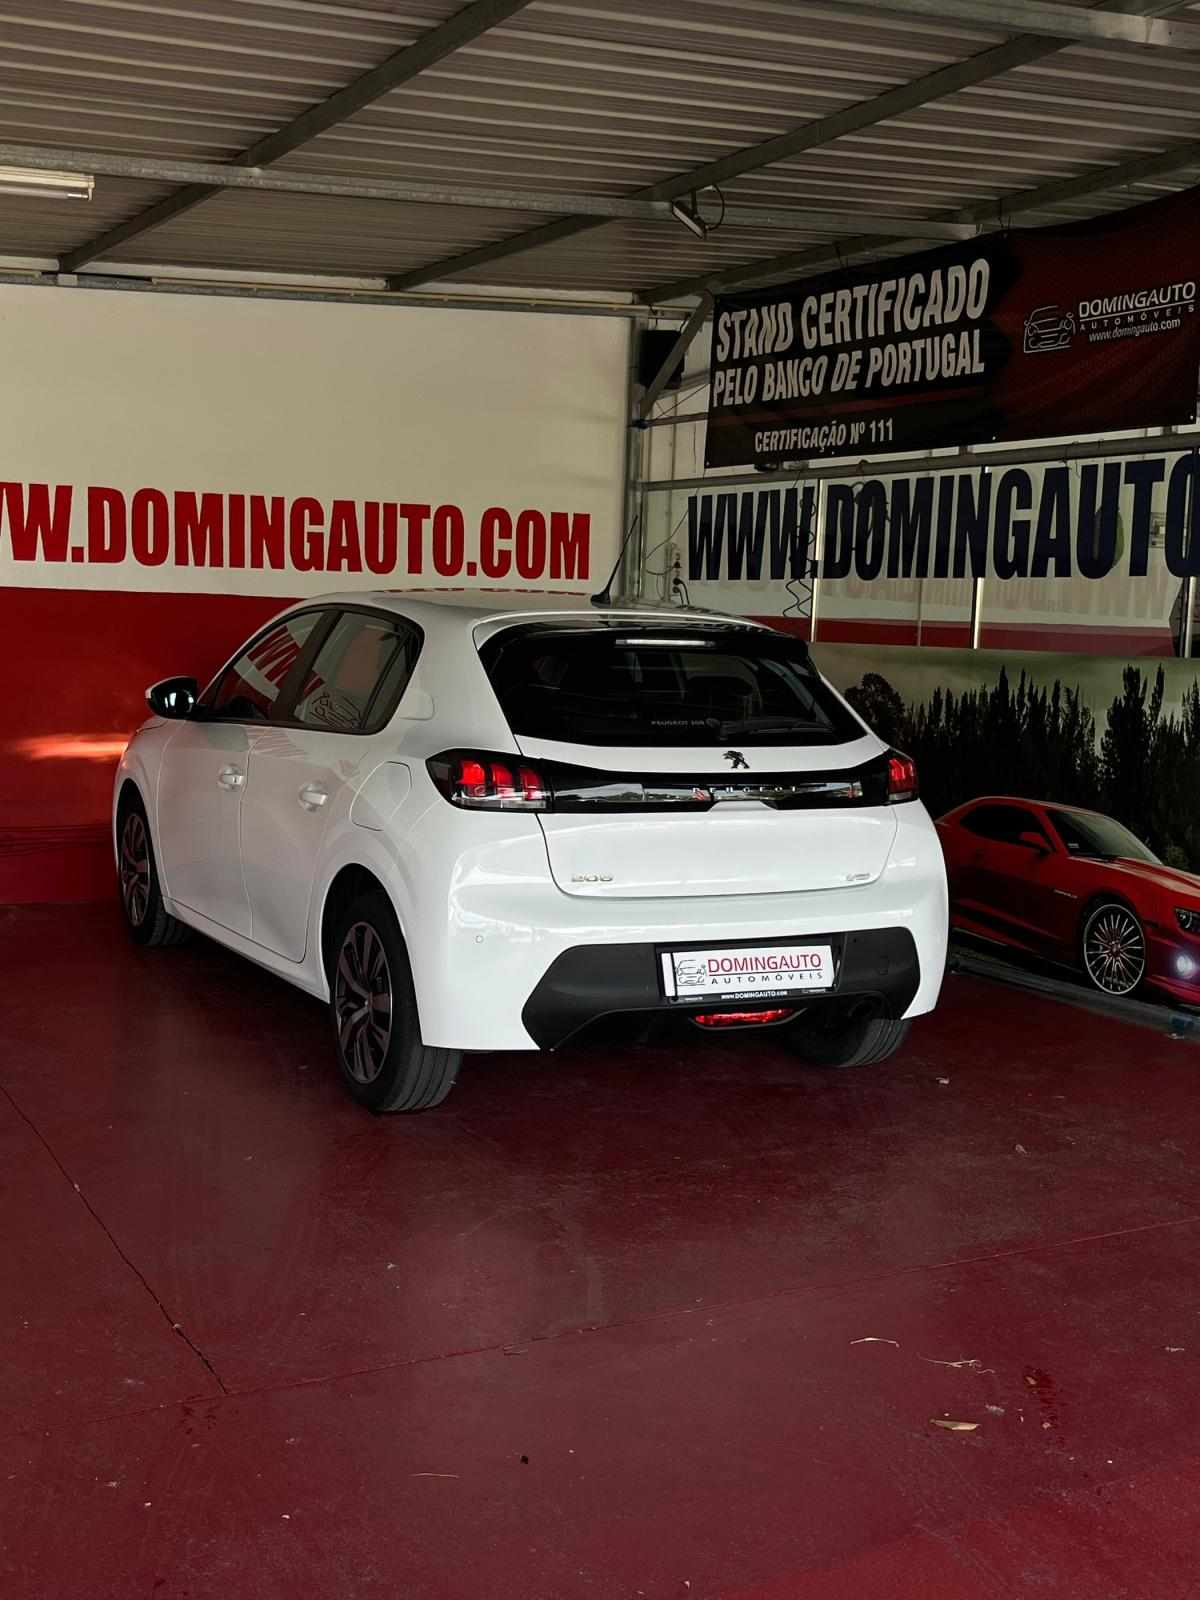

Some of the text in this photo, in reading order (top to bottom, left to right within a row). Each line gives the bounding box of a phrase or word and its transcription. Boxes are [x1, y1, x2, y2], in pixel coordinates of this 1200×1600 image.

[716, 258, 991, 363] STAND CERTIFICADO
[1078, 281, 1196, 318] DOMINGAUTO
[1080, 305, 1195, 331] AUTOMÓVEIS
[1088, 318, 1181, 342] www.domingauto.com
[712, 328, 985, 408] PELO BANCO DE PORTUGAL
[754, 420, 847, 454] CERTIFICAÇÃO
[869, 417, 894, 443] 111
[0, 481, 591, 580] W.DOMINGAUTO.COM
[707, 953, 822, 973] DOMINGAUTO
[711, 972, 823, 985] AUTOMÓVEIS
